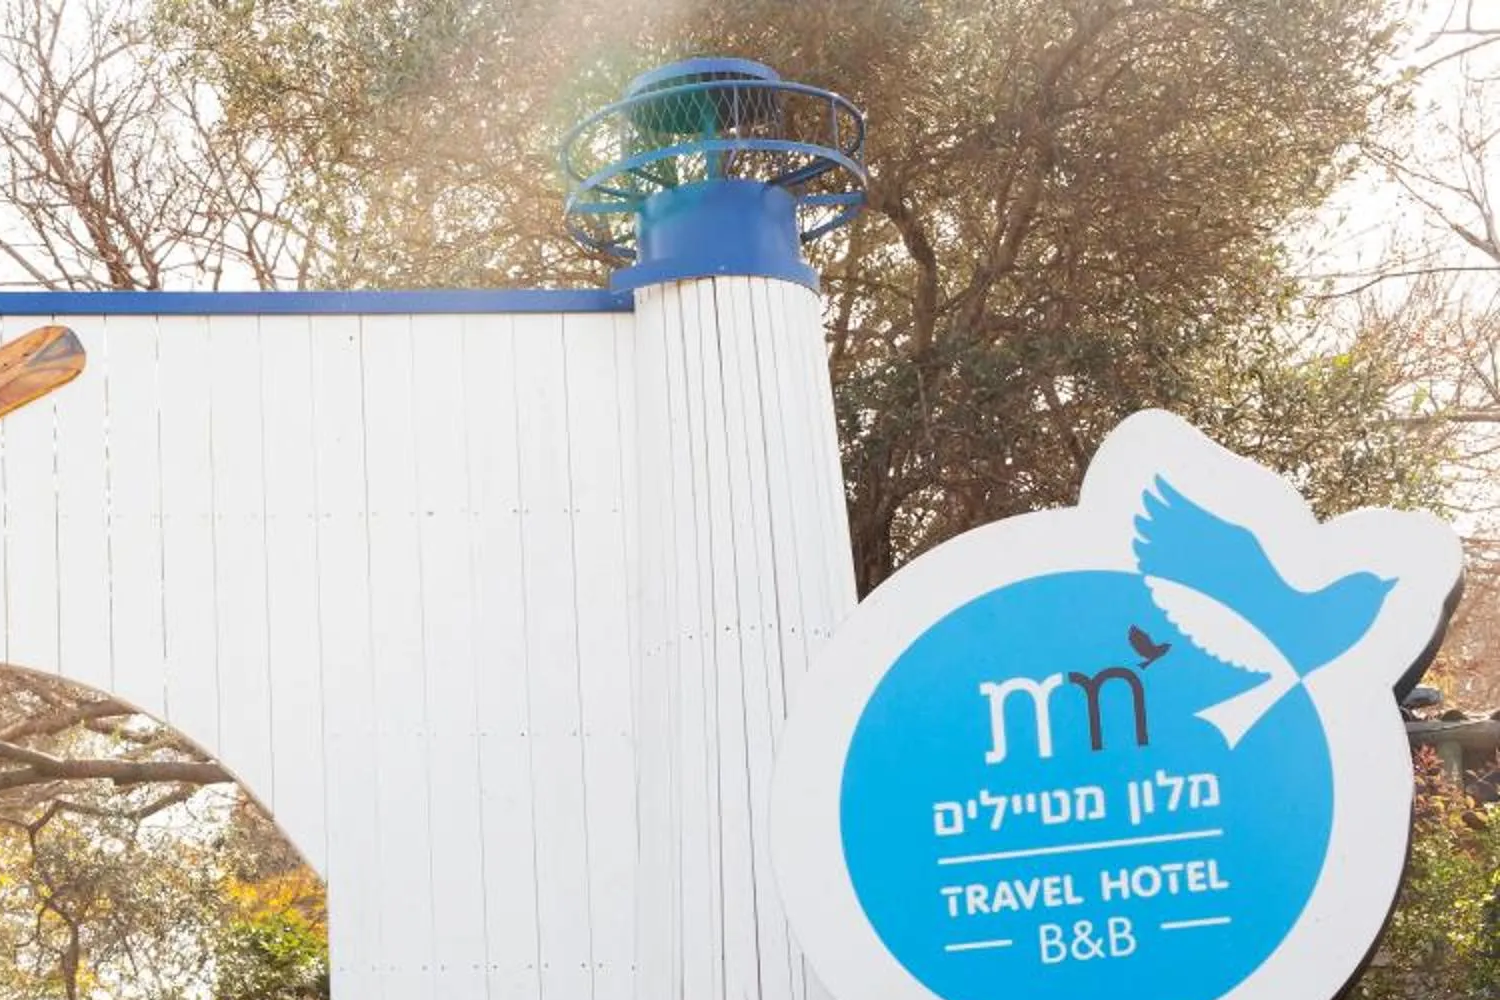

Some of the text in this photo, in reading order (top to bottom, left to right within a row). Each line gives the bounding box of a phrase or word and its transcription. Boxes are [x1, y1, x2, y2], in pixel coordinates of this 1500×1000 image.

[934, 770, 1221, 835] מלון מטיילים
[941, 860, 1229, 917] TRAVEL HOTEL
[1039, 917, 1137, 963] B&B
